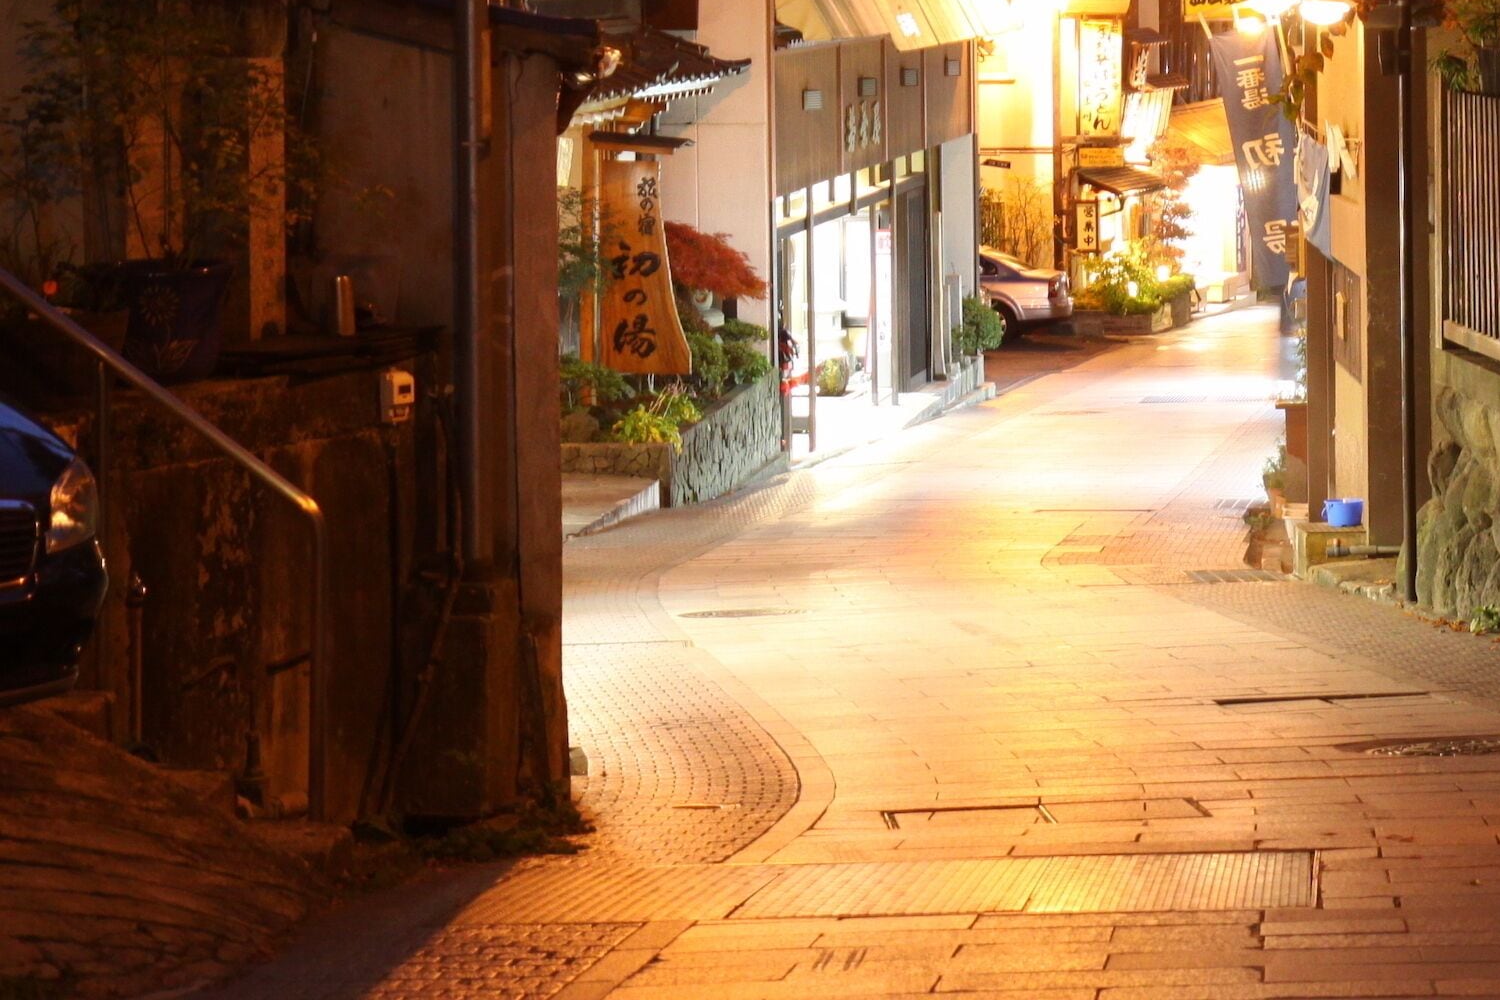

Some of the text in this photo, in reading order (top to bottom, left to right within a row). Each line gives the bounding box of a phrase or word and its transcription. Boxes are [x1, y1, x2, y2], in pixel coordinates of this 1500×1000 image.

[637, 176, 658, 236] 旅の宿
[1083, 205, 1095, 247] 営業中
[612, 240, 662, 359] 初の湯
